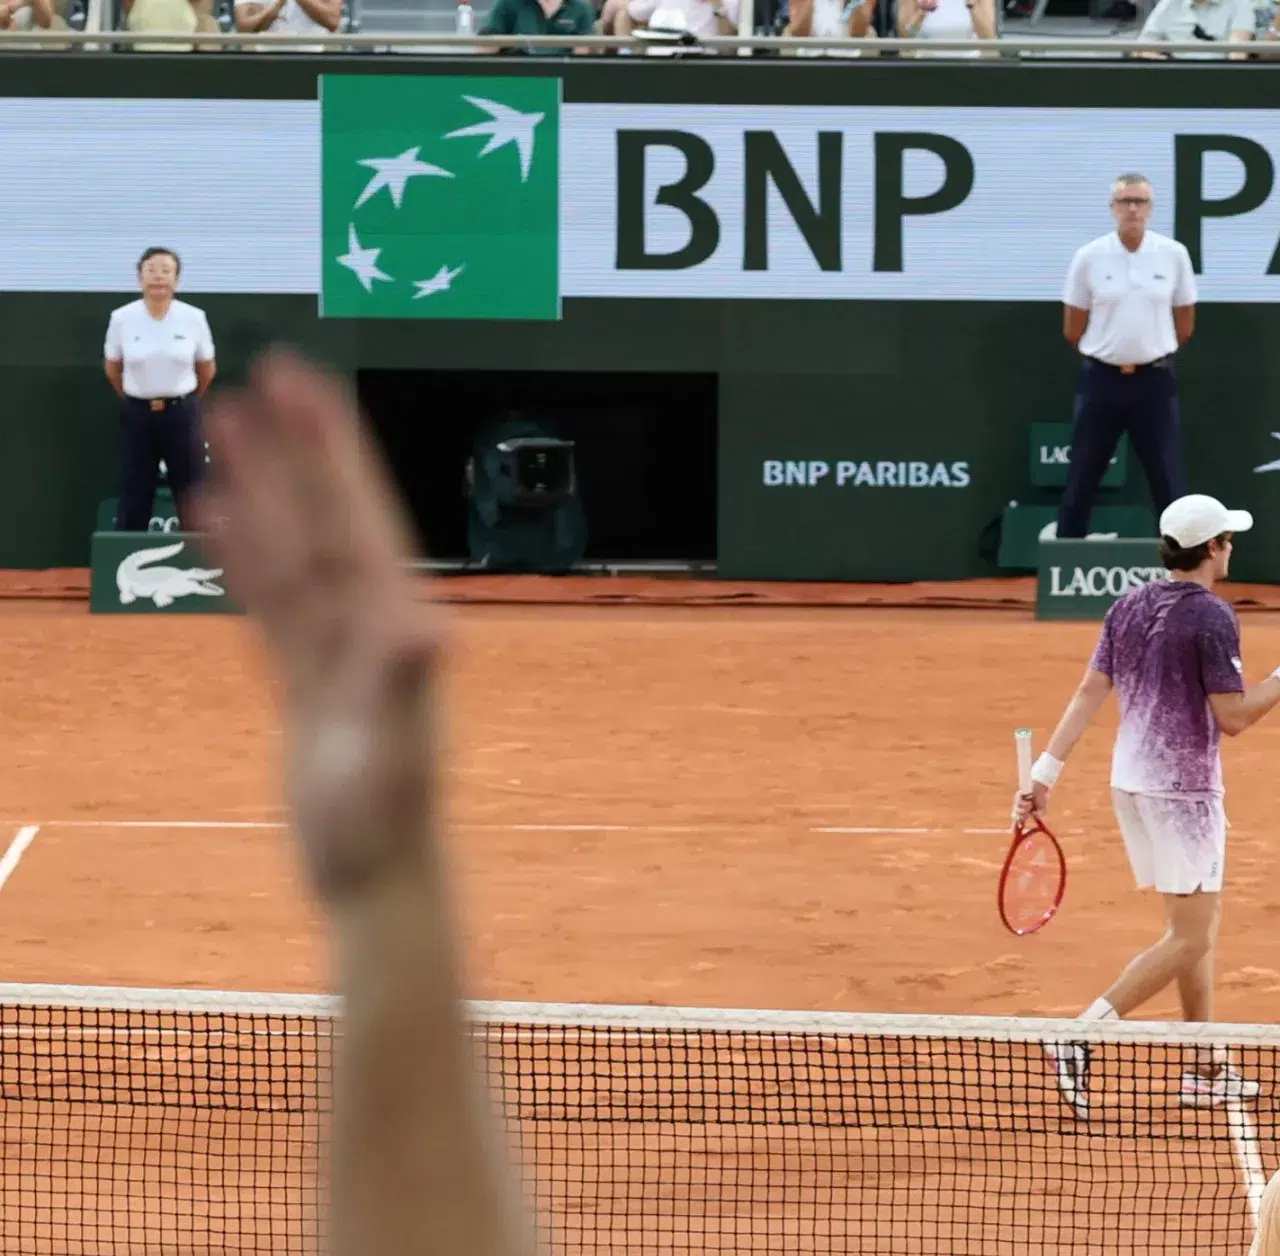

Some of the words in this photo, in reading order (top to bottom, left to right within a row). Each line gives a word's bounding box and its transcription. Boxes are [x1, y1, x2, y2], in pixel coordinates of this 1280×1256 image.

[615, 129, 975, 273] BNP
[762, 460, 830, 486] BNP
[836, 461, 970, 487] PARIBAS
